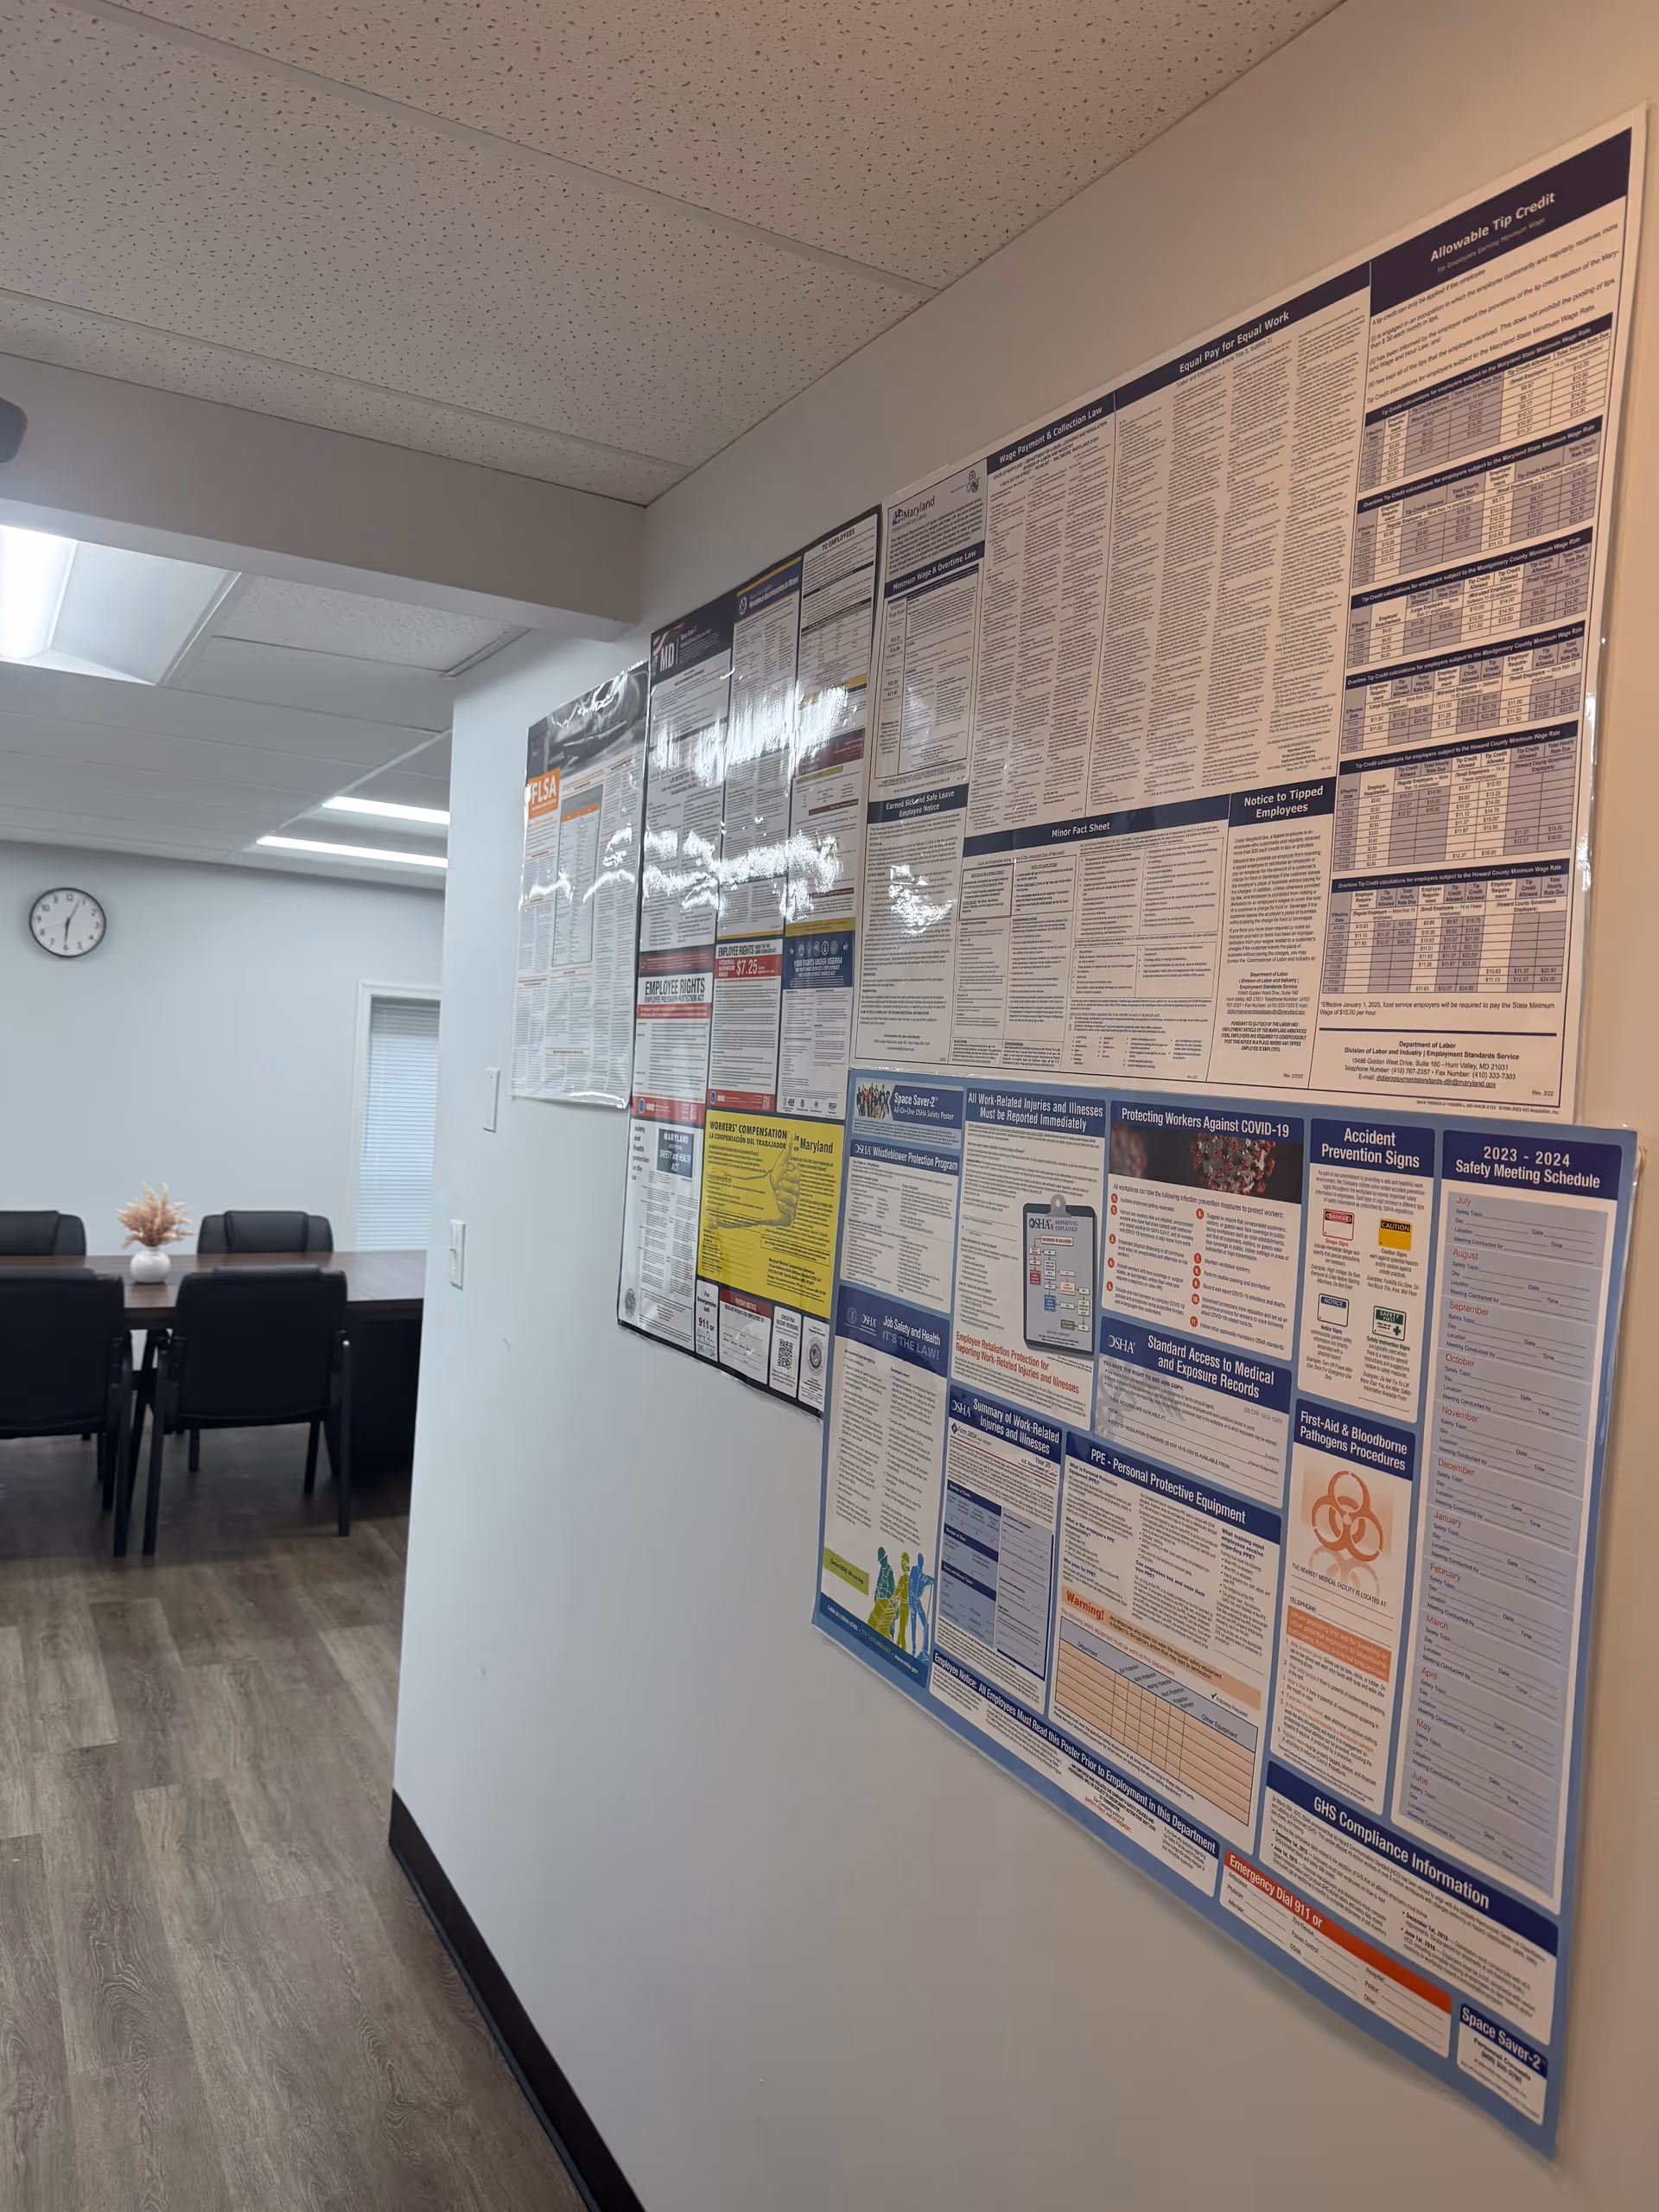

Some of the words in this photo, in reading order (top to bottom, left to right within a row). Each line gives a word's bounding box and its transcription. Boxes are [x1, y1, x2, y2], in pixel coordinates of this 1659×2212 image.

[1431, 226, 1489, 262] Allowable
[1492, 215, 1512, 230] Tip
[1516, 193, 1555, 219] Credit
[1180, 354, 1202, 373] Equal
[1205, 347, 1220, 360] Pay
[1222, 340, 1235, 352] for
[1237, 324, 1262, 344] Equal
[1264, 311, 1289, 330] Work
[1000, 450, 1016, 463] Wage
[1018, 435, 1046, 454] Payment
[1046, 431, 1052, 440] &
[1053, 415, 1086, 436] Collection
[1088, 407, 1102, 419] Law
[903, 495, 936, 518] Maryland
[660, 643, 674, 672] MD
[531, 775, 556, 804] FLSA
[887, 800, 904, 810] Earned
[926, 793, 938, 802] Safe
[938, 791, 955, 799] Leave
[1244, 795, 1274, 806] Notice
[1277, 792, 1287, 802] to
[1289, 785, 1323, 800] Tipped
[899, 807, 922, 817] Employee
[924, 804, 939, 812] Notice
[1256, 804, 1308, 818] Employees
[1052, 829, 1071, 837] Minor
[1072, 825, 1087, 835] Fact
[1089, 822, 1110, 832] Sheet
[736, 959, 758, 976] $7.25
[645, 979, 678, 995] EMPLOYEE
[680, 977, 705, 994] RIGHTS
[894, 1092, 912, 1105] Space
[968, 1092, 976, 1103] All
[978, 1093, 1022, 1109] Work-Related
[1024, 1097, 1051, 1112] Injuries
[1052, 1102, 1068, 1114] and
[1069, 1102, 1103, 1117] Illnesses
[710, 1122, 737, 1133] WORKERS'
[739, 1124, 787, 1140] COMPENSATION
[980, 1107, 995, 1119] Must
[997, 1109, 1005, 1120] be
[1007, 1109, 1038, 1124] Reported
[1040, 1114, 1087, 1133] Immediately
[1122, 1108, 1163, 1126] Protecting
[1166, 1112, 1201, 1128] Workers
[1203, 1116, 1239, 1132] Against
[1242, 1120, 1289, 1137] COVID-19
[800, 1138, 833, 1154] Maryland
[1344, 1128, 1395, 1146] Accident
[873, 1146, 907, 1161] Whistleblower
[907, 1152, 934, 1166] Protection
[934, 1157, 958, 1172] Program
[1322, 1143, 1382, 1163] Prevention
[1385, 1150, 1420, 1169] Signs
[1484, 1146, 1516, 1161] 2023
[1535, 1151, 1570, 1167] 2024
[1456, 1160, 1491, 1178] Safety
[1494, 1164, 1541, 1184] Meeting
[1543, 1169, 1600, 1188] Schedule
[1457, 1196, 1471, 1207] July
[1381, 1219, 1411, 1233] CAUTION
[1453, 1249, 1478, 1260] August
[1450, 1300, 1489, 1316] September
[883, 1315, 893, 1328] Job
[893, 1319, 911, 1337] Safety
[911, 1328, 921, 1338] and
[922, 1328, 940, 1345] Health
[882, 1330, 897, 1344] IT'S
[899, 1336, 914, 1351] THE
[917, 1343, 939, 1360] LAW!
[957, 1331, 981, 1350] Employee
[982, 1339, 1010, 1357] Retaliation
[1011, 1350, 1039, 1367] Protection
[1040, 1359, 1049, 1370] for
[956, 1343, 981, 1363] Reporting
[981, 1351, 1017, 1371] Work-Related
[1018, 1363, 1039, 1380] Injuries
[1040, 1374, 1052, 1384] and
[1052, 1376, 1079, 1394] Illnesses
[1147, 1335, 1186, 1358] Standard
[1188, 1347, 1220, 1369] Access
[1223, 1357, 1231, 1372] to
[1235, 1361, 1276, 1385] Medical
[1446, 1353, 1475, 1367] October
[1158, 1357, 1174, 1370] and
[1177, 1360, 1217, 1384] Exposure
[1220, 1373, 1259, 1398] Records
[973, 1398, 1004, 1422] Summary
[1005, 1413, 1012, 1424] of
[1014, 1414, 1059, 1444] Work-Related
[1442, 1406, 1479, 1422] November
[980, 1414, 1004, 1435] Injuries
[1006, 1427, 1018, 1441] and
[1020, 1431, 1050, 1454] Illnesses
[1300, 1410, 1339, 1433] First-Aid
[1341, 1424, 1349, 1437] &
[1351, 1427, 1407, 1454] Bloodborne
[1300, 1426, 1348, 1452] Pathogens
[1351, 1442, 1405, 1471] Procedures
[1438, 1458, 1475, 1476] December
[1091, 1448, 1106, 1465] PPE
[1113, 1458, 1147, 1483] Personal
[1150, 1472, 1194, 1502] Protective
[1196, 1491, 1245, 1524] Equipment
[1434, 1511, 1462, 1529] January
[1430, 1562, 1461, 1582] February
[1066, 1590, 1104, 1620] Warning!
[934, 1652, 958, 1675] Employee
[960, 1669, 978, 1690] Notice:
[987, 1688, 1016, 1716] Employees
[1017, 1709, 1032, 1726] Must
[1033, 1720, 1048, 1737] Read
[1049, 1731, 1060, 1745] this
[1061, 1738, 1081, 1760] Poster
[1082, 1753, 1097, 1771] Prior
[1097, 1764, 1105, 1777] to
[1106, 1770, 1148, 1806] Employment
[1149, 1798, 1156, 1812] in
[1158, 1804, 1171, 1822] this
[1173, 1814, 1216, 1854] Department
[1314, 1796, 1337, 1821] GHS
[1339, 1811, 1408, 1863] Compliance
[1412, 1853, 1491, 1909] Information
[1230, 1854, 1275, 1896] Emergency
[1276, 1886, 1293, 1908] Dial
[1294, 1900, 1310, 1920] 911
[1313, 1915, 1323, 1928] or
[1462, 2007, 1496, 2038] Space
